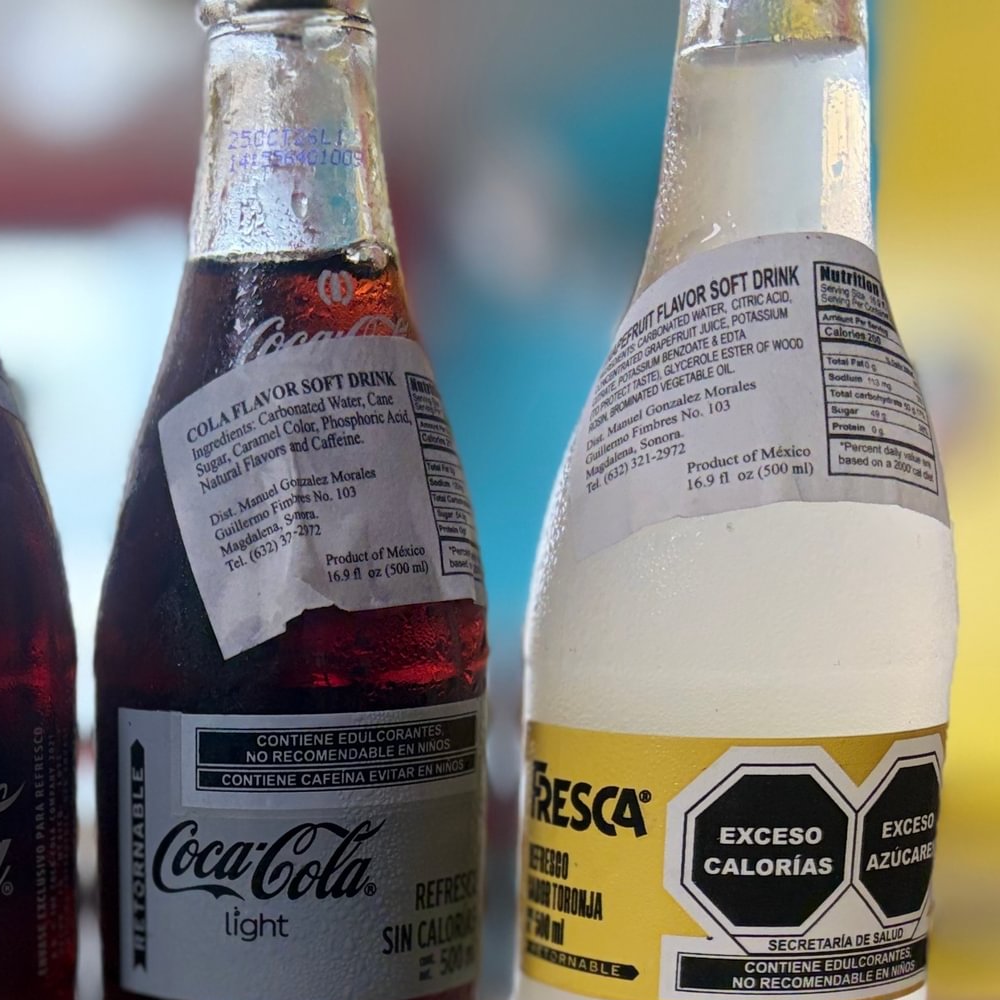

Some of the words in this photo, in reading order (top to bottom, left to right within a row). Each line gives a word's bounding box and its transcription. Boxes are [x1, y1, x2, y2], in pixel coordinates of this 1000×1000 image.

[656, 284, 706, 323] FLAVOR
[709, 271, 749, 301] SOFT
[752, 264, 800, 290] DRINK
[820, 265, 880, 297] Nutrition
[637, 312, 690, 350] CARBONATED
[691, 302, 728, 321] WATER,
[731, 293, 764, 311] CITRIC
[644, 326, 699, 357] GRAPEFRUIT
[731, 307, 789, 327] POTASSIUM
[824, 326, 866, 340] Calories
[662, 338, 710, 363] BENZOATE
[720, 329, 747, 346] EDTA
[663, 351, 720, 377] GLYCEROLE
[721, 343, 755, 360] ESTER
[756, 340, 770, 354] OF
[772, 337, 804, 351] WOOD
[826, 356, 850, 366] Total
[660, 366, 714, 393] VEGETABLE
[716, 363, 735, 377] OIL.
[828, 373, 863, 383] Sodium
[186, 411, 231, 444] COLA
[231, 380, 300, 420] FLAVOR
[301, 373, 344, 395] SOFT
[348, 370, 397, 388] DRINK
[607, 410, 642, 437] Manuel
[645, 393, 701, 417] Gonzalez
[704, 380, 757, 399] Morales
[830, 389, 853, 399] Total
[191, 421, 256, 461] Ingredients:
[258, 399, 326, 426] Carbonated
[327, 394, 366, 410] Water,
[367, 391, 394, 406] Cane
[632, 414, 678, 438] Fimbres
[681, 407, 704, 421] No.
[708, 398, 731, 415] 103
[831, 405, 859, 417] Sugar
[640, 430, 684, 450] Sonora.
[831, 422, 866, 432] Protein
[195, 453, 232, 478] Sugar,
[232, 427, 281, 459] Caramel
[283, 419, 320, 439] Color,
[322, 410, 385, 431] Phosphoric
[386, 409, 413, 426] Acid,
[687, 455, 738, 474] Product
[743, 447, 759, 463] of
[761, 444, 811, 461] México
[199, 462, 242, 494] Natural
[243, 443, 287, 472] Flavors
[289, 436, 309, 453] and
[311, 431, 365, 451] Caffeine.
[603, 461, 629, 485] (632)
[631, 442, 687, 469] 321-2972
[687, 474, 715, 491] 16.9
[720, 471, 729, 485] fl
[738, 470, 755, 481] oz
[757, 462, 788, 480] (500
[791, 461, 815, 476] ml)
[838, 454, 869, 466] based
[871, 459, 883, 468] on
[209, 505, 238, 527] Dist.
[238, 483, 279, 512] Manuel
[330, 467, 376, 484] Morales
[214, 510, 270, 541] Guillermo
[313, 490, 334, 503] No.
[336, 486, 357, 500] 103
[220, 522, 284, 557] Magdalena,
[325, 552, 369, 566] Product
[371, 551, 386, 561] of
[386, 543, 426, 559] México
[225, 556, 248, 573] Tel.
[249, 539, 279, 564] (632)
[327, 568, 351, 583] 16.9
[367, 567, 382, 579] oz
[385, 561, 411, 579] (500
[412, 560, 430, 575] ml)
[246, 750, 268, 763] NO
[273, 745, 395, 763] RECOMENDABLE
[398, 743, 415, 755] EN
[417, 737, 450, 754] NIÑOS
[256, 733, 334, 747] CONTIENE
[221, 774, 297, 787] CONTIENE
[301, 769, 366, 785] CAFEÍNA
[369, 765, 415, 781] EVITAR
[418, 764, 433, 777] EN
[530, 760, 648, 838] FRESCA
[720, 826, 823, 846] EXCESO
[882, 811, 934, 838] EXCESO
[152, 819, 387, 901] Coca-Cola
[704, 855, 833, 877] CALORÍAS
[552, 883, 603, 921] TORONJA
[225, 906, 290, 941] light
[382, 922, 413, 955] SIN
[768, 934, 854, 951] SECRETARÍA
[856, 933, 871, 946] DE
[873, 928, 904, 943] SALUD
[732, 977, 756, 989] NO
[760, 971, 874, 989] RECOMENDABLE
[875, 968, 889, 979] EN
[891, 959, 916, 978] NIÑOS
[744, 961, 822, 974] CONTIENE
